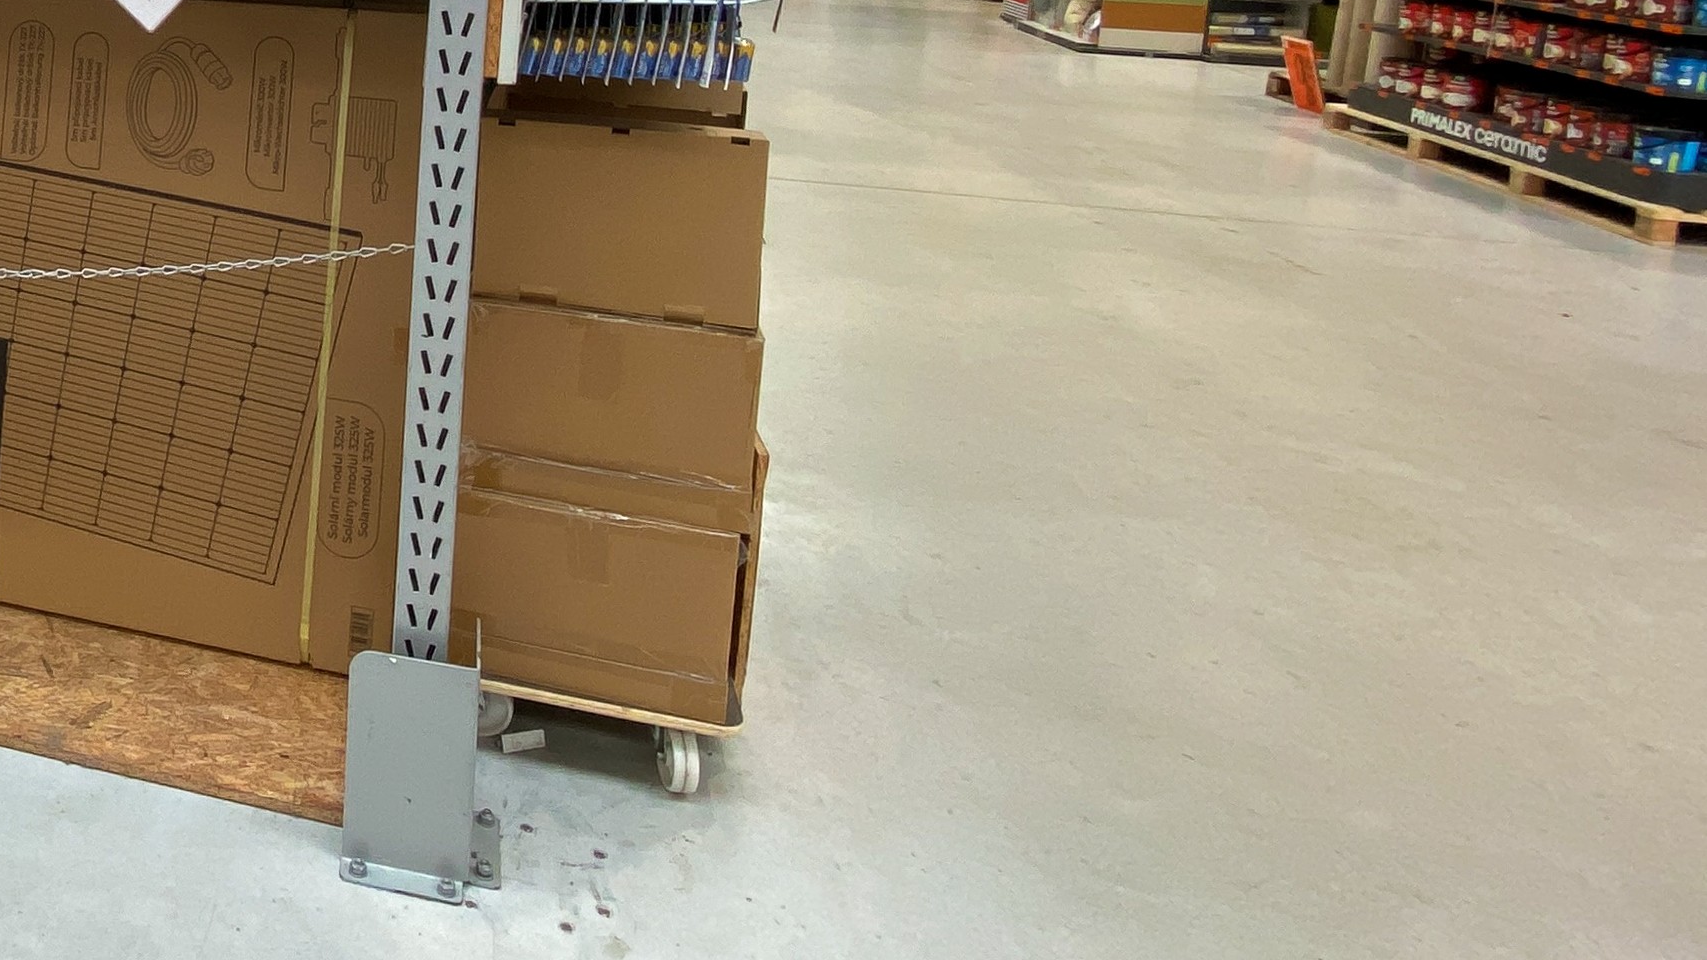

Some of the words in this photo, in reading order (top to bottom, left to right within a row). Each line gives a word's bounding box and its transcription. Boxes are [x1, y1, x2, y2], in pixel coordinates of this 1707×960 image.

[1410, 107, 1472, 141] PRIMALEX
[332, 452, 343, 493] modul
[348, 451, 359, 493] modul
